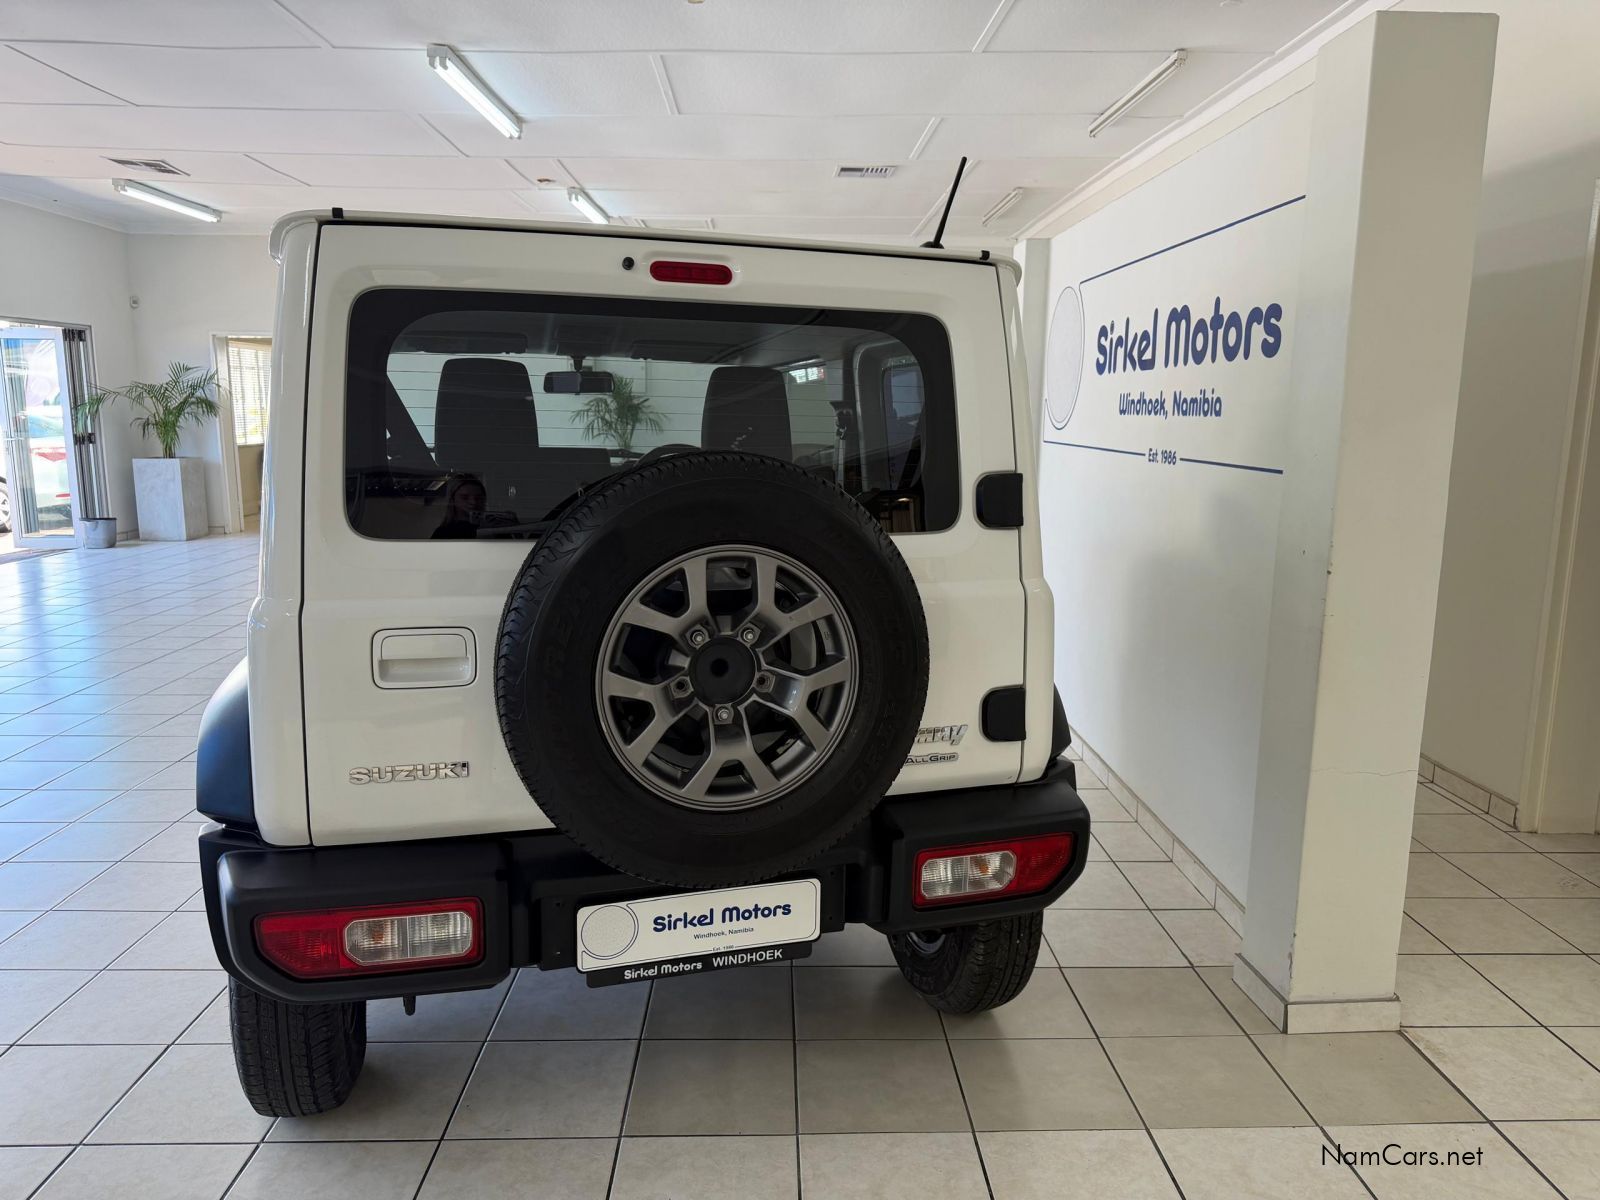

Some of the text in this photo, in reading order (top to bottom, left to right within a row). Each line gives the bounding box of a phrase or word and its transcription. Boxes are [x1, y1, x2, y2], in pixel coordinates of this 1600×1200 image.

[1095, 295, 1283, 376] Sirkel Motors
[1118, 388, 1222, 420] Windhoek, Namibia
[1147, 448, 1177, 466] Est. 1986
[348, 761, 470, 785] SUZUKI
[652, 903, 792, 933] Sirkel Motors
[693, 927, 754, 940] Windhoek, Namibia
[623, 948, 783, 980] Sirkel Motors WINDHOEK
